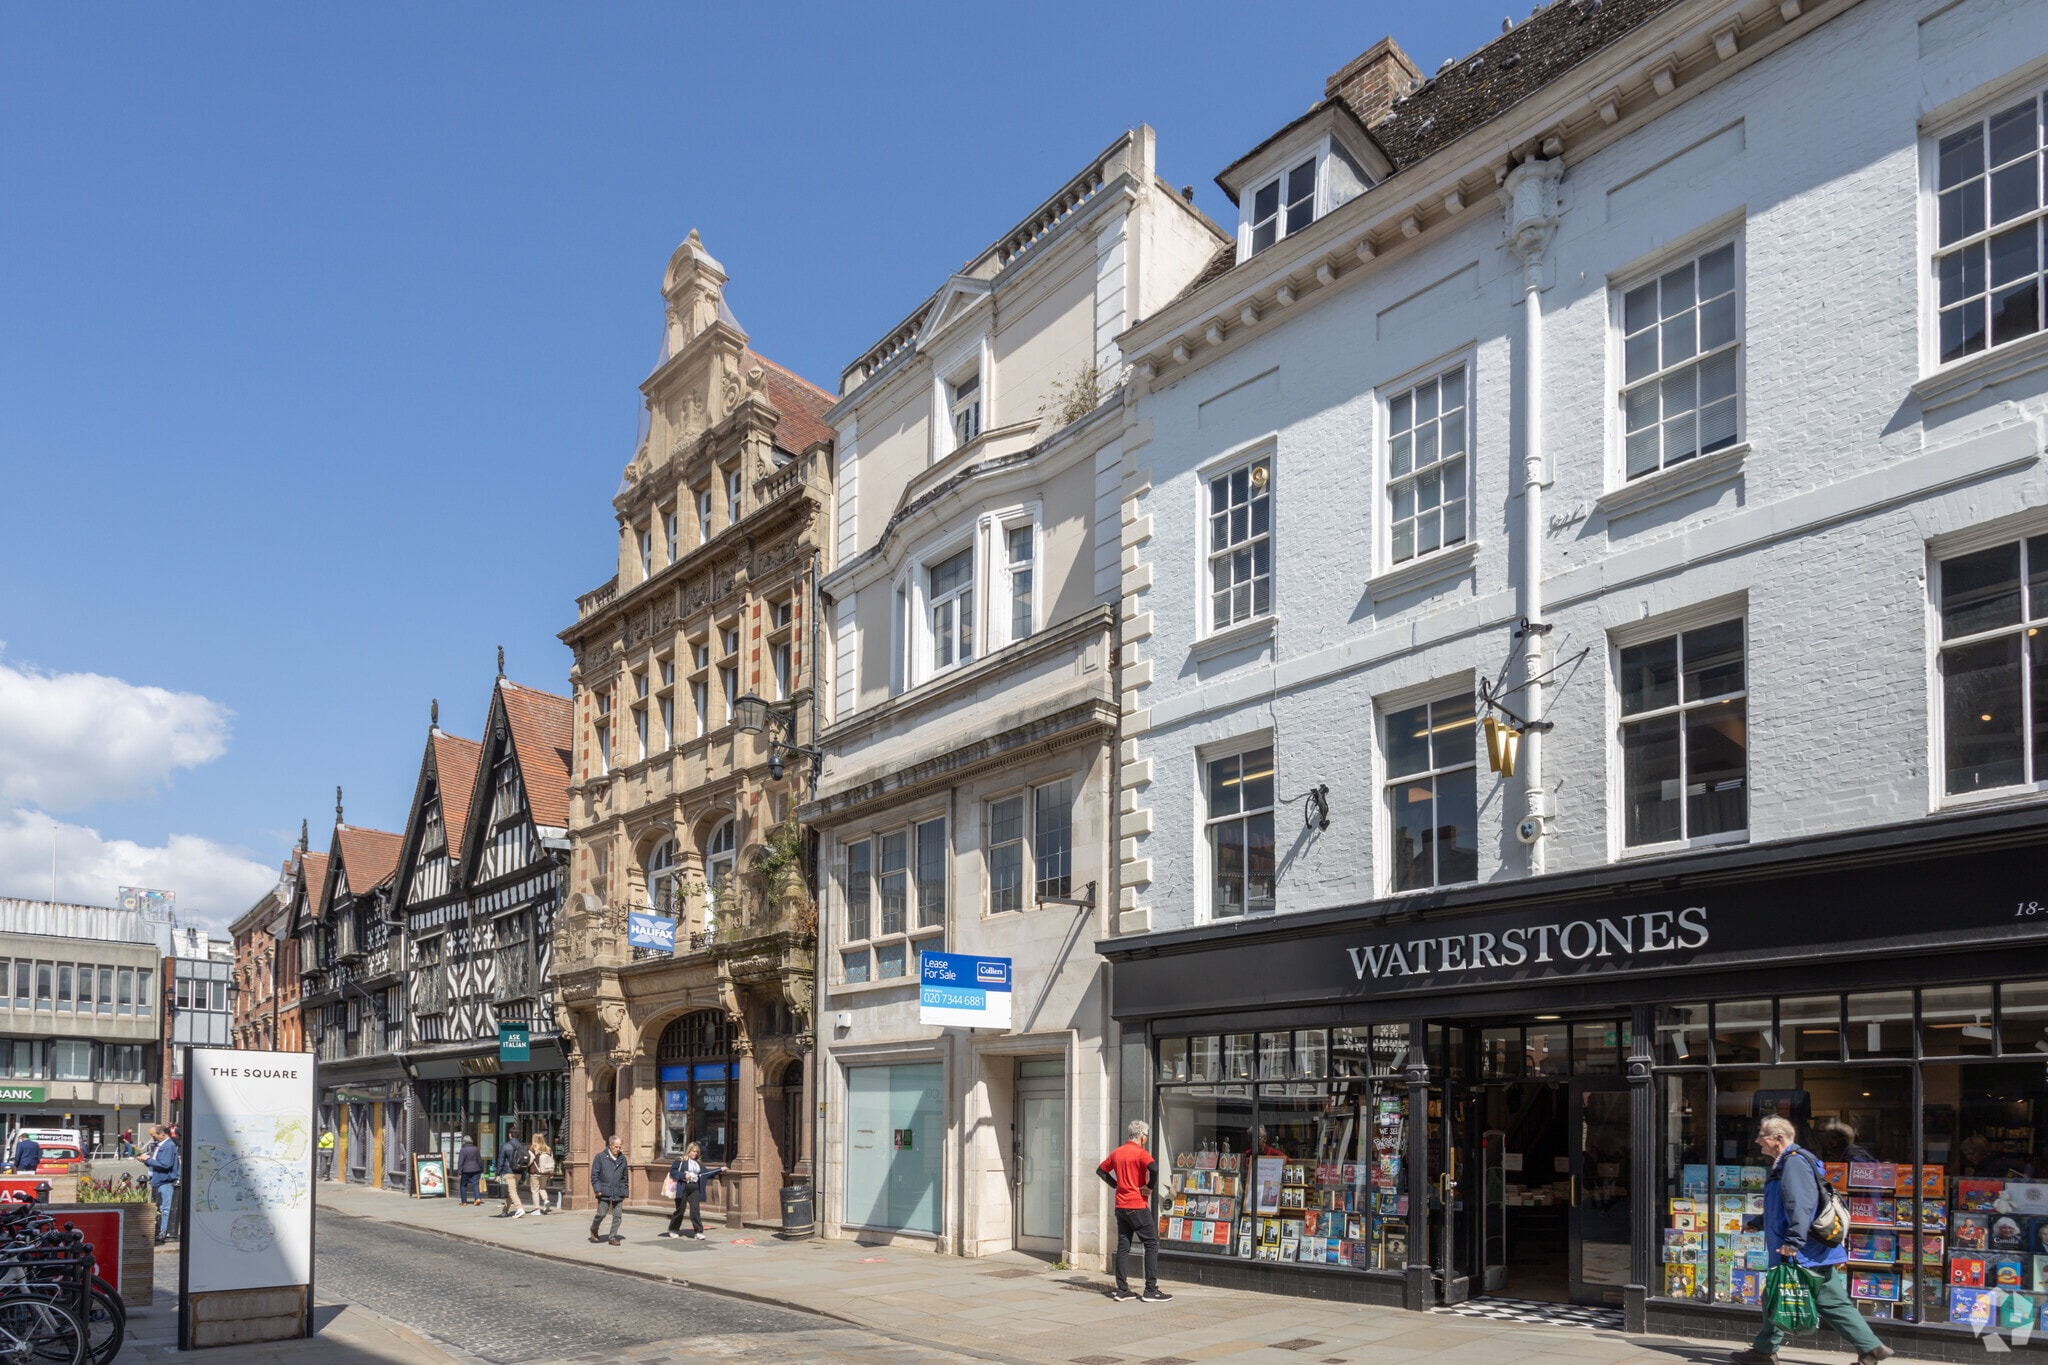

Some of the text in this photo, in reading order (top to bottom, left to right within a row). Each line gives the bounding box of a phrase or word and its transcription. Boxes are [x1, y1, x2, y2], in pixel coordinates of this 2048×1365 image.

[2014, 901, 2048, 917] 18-
[631, 924, 673, 940] HALIFAX
[1346, 906, 1709, 980] WATERSTONES
[924, 957, 948, 969] Lease
[924, 968, 957, 981] For Sale
[980, 966, 1003, 975] Colliers
[923, 992, 984, 1007] 020 7344 6881
[210, 1067, 298, 1079] THE SQUARE
[703, 1095, 726, 1104] HALIFA
[28, 1133, 73, 1141] enterprise
